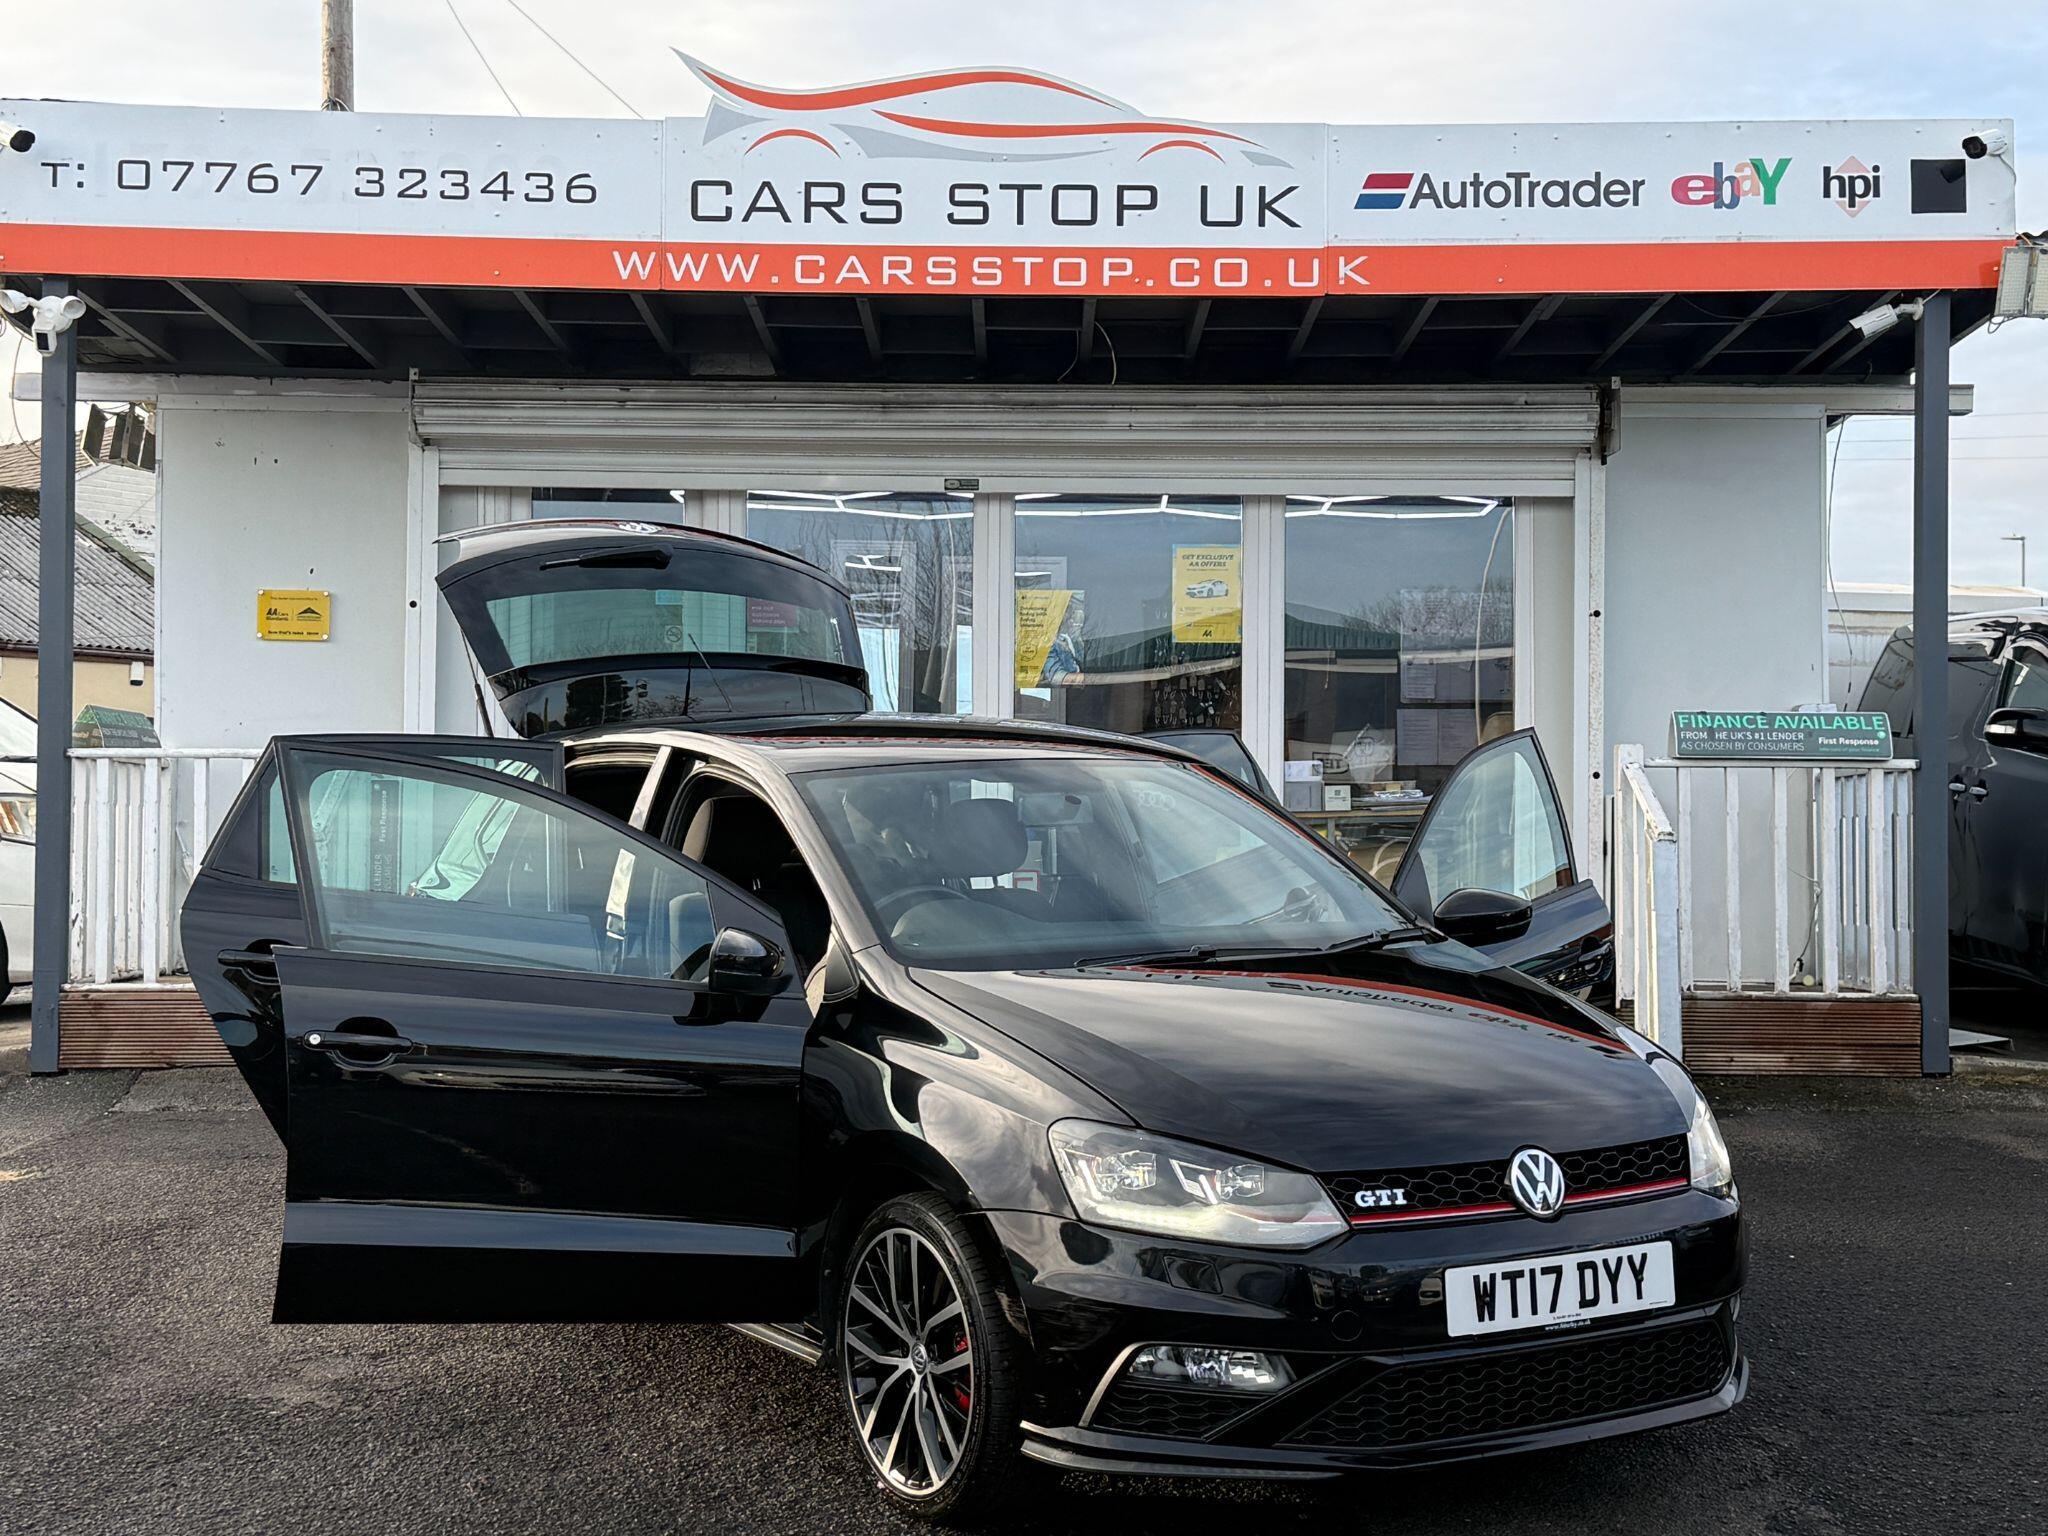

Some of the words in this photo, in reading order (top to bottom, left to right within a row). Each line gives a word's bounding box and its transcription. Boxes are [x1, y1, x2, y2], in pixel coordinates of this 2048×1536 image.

[41, 162, 86, 188] T:
[118, 160, 324, 196] 07767
[355, 166, 597, 204] 323436
[1409, 171, 1645, 210] AutoTrader
[1823, 165, 1881, 208] hpi
[691, 180, 904, 224] CARS
[946, 183, 1158, 227] STOP
[1200, 185, 1303, 229] UK
[612, 250, 1370, 288] WWW.CARSSTOP.CO.UK
[1678, 715, 1769, 729] FINANCE
[1774, 715, 1885, 731] AVAILABLE
[1681, 731, 1707, 739] FROM
[1730, 731, 1752, 740] UK'S
[1767, 732, 1804, 740] LENDER
[1819, 737, 1837, 745] First
[1839, 737, 1879, 746] Response
[1681, 741, 1693, 750] AS
[1694, 742, 1734, 750] CHOSEN
[1735, 742, 1746, 750] BY
[1747, 742, 1805, 751] CONSUMERS
[1354, 1188, 1408, 1207] GTI
[1473, 1265, 1563, 1323] WT17
[1577, 1252, 1648, 1309] DYY
